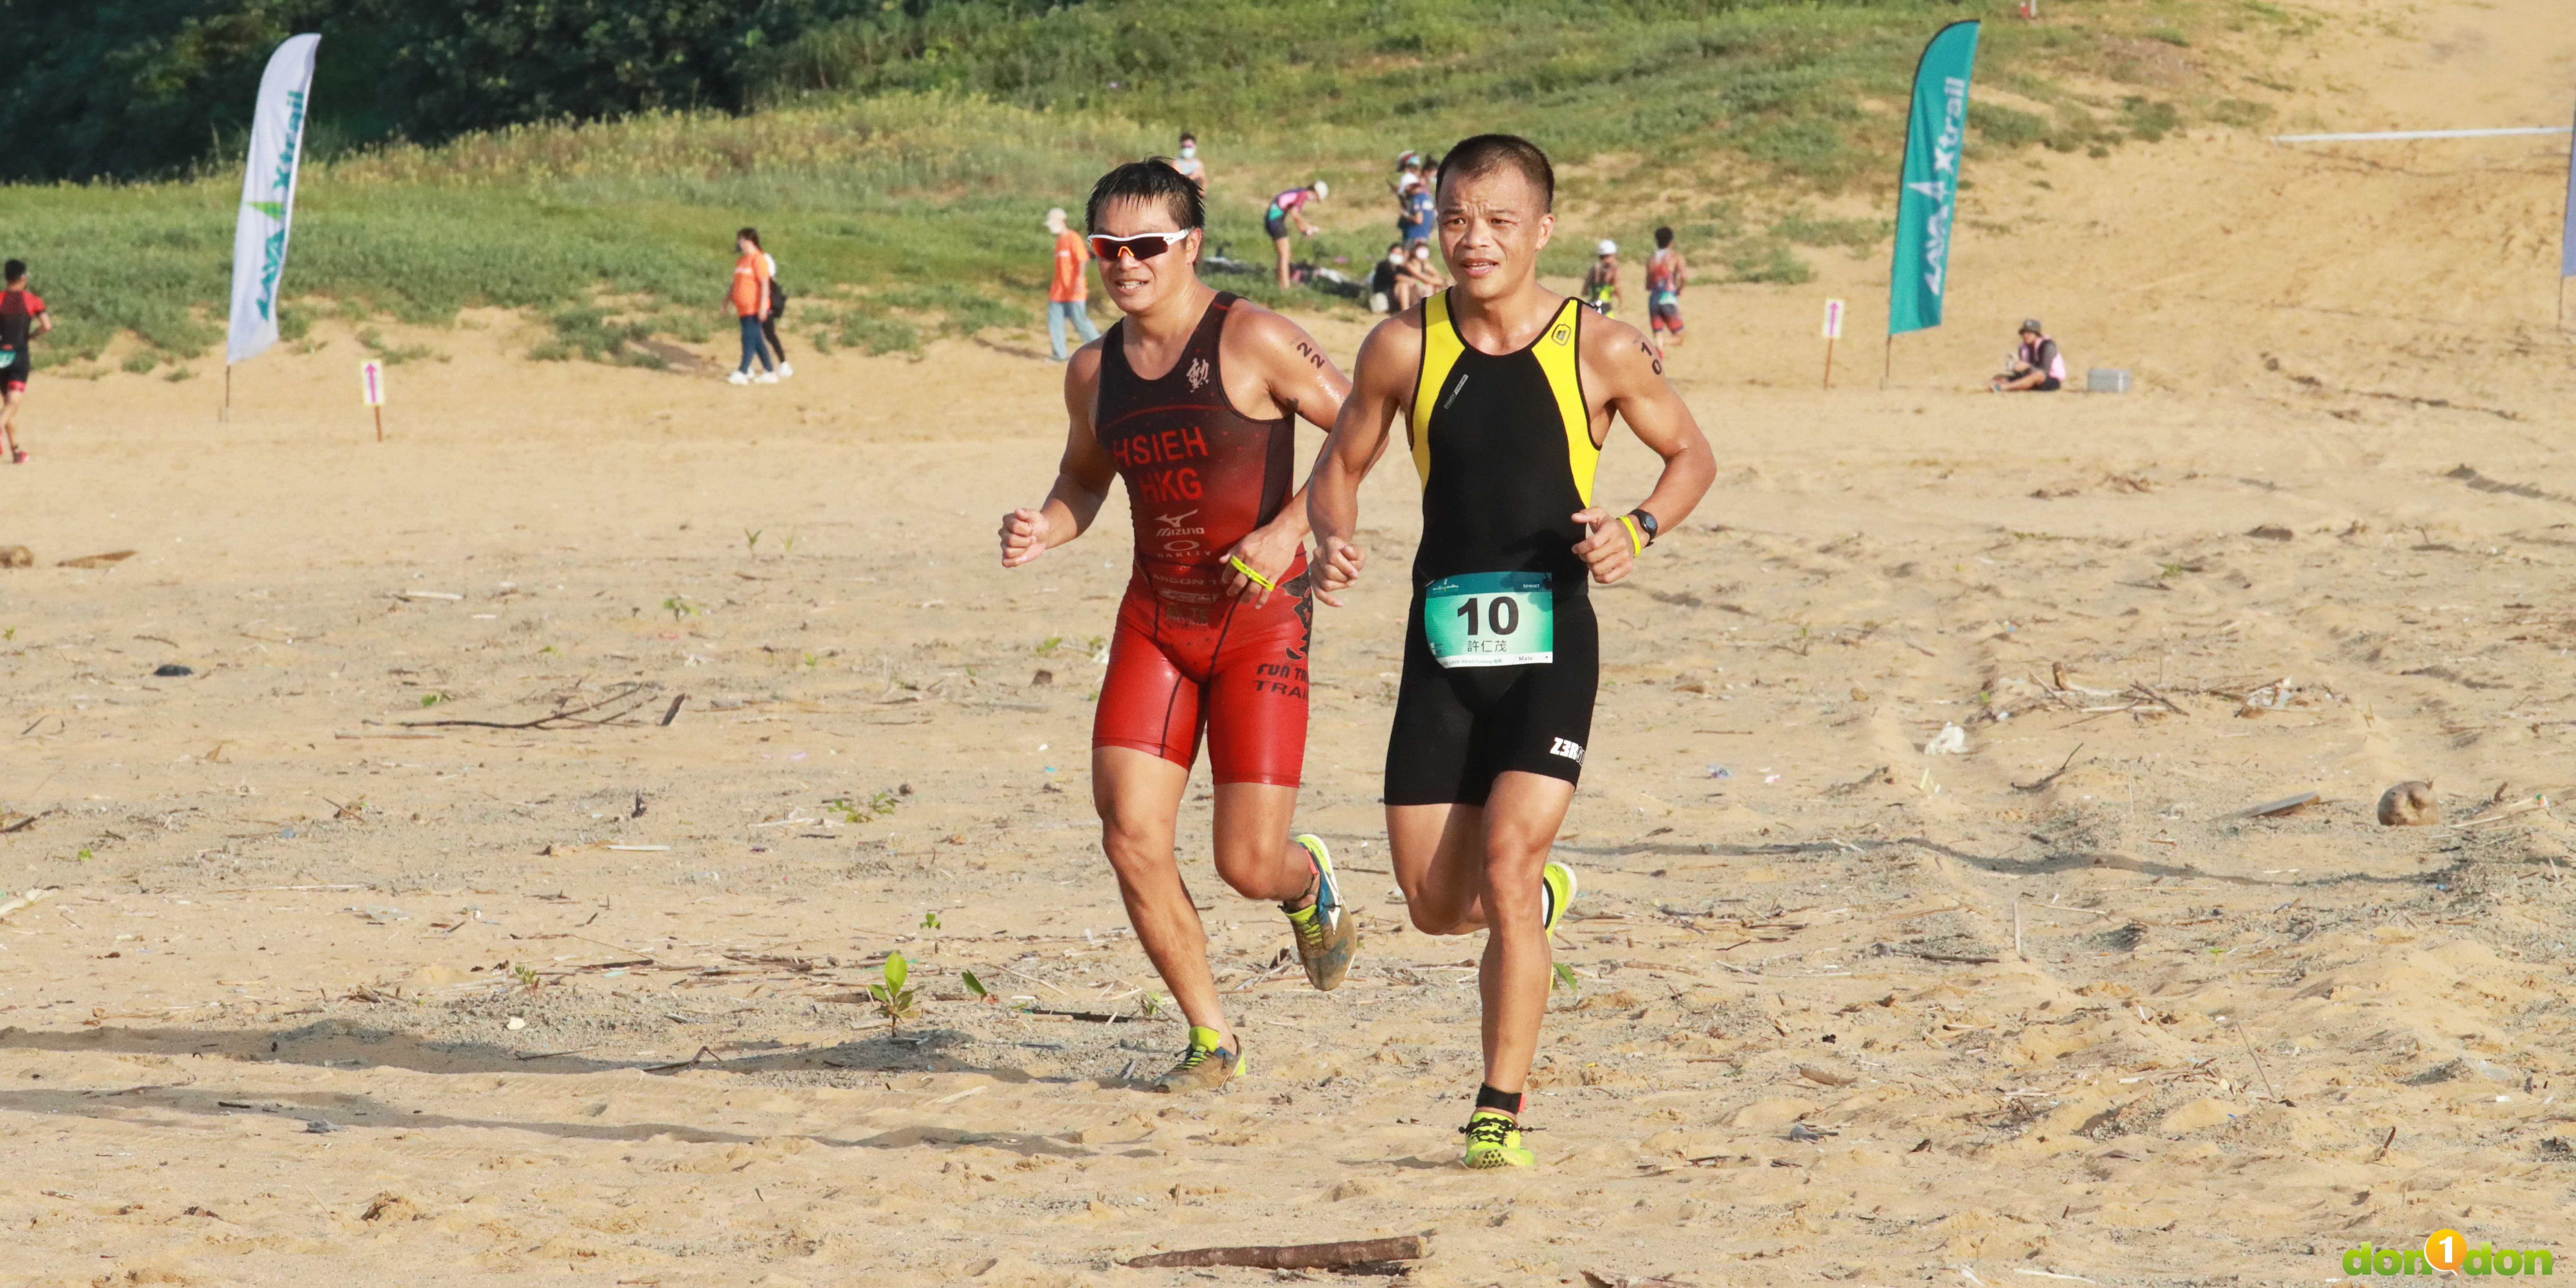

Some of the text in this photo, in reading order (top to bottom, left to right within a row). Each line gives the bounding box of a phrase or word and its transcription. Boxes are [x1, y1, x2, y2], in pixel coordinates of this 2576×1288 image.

[1297, 342, 1325, 369] 22
[1641, 341, 1662, 375] 10
[1113, 426, 1208, 467] HSIEH
[1138, 467, 1203, 503] HKG
[1457, 596, 1519, 636] 10
[1467, 640, 1507, 653] 許仁茂
